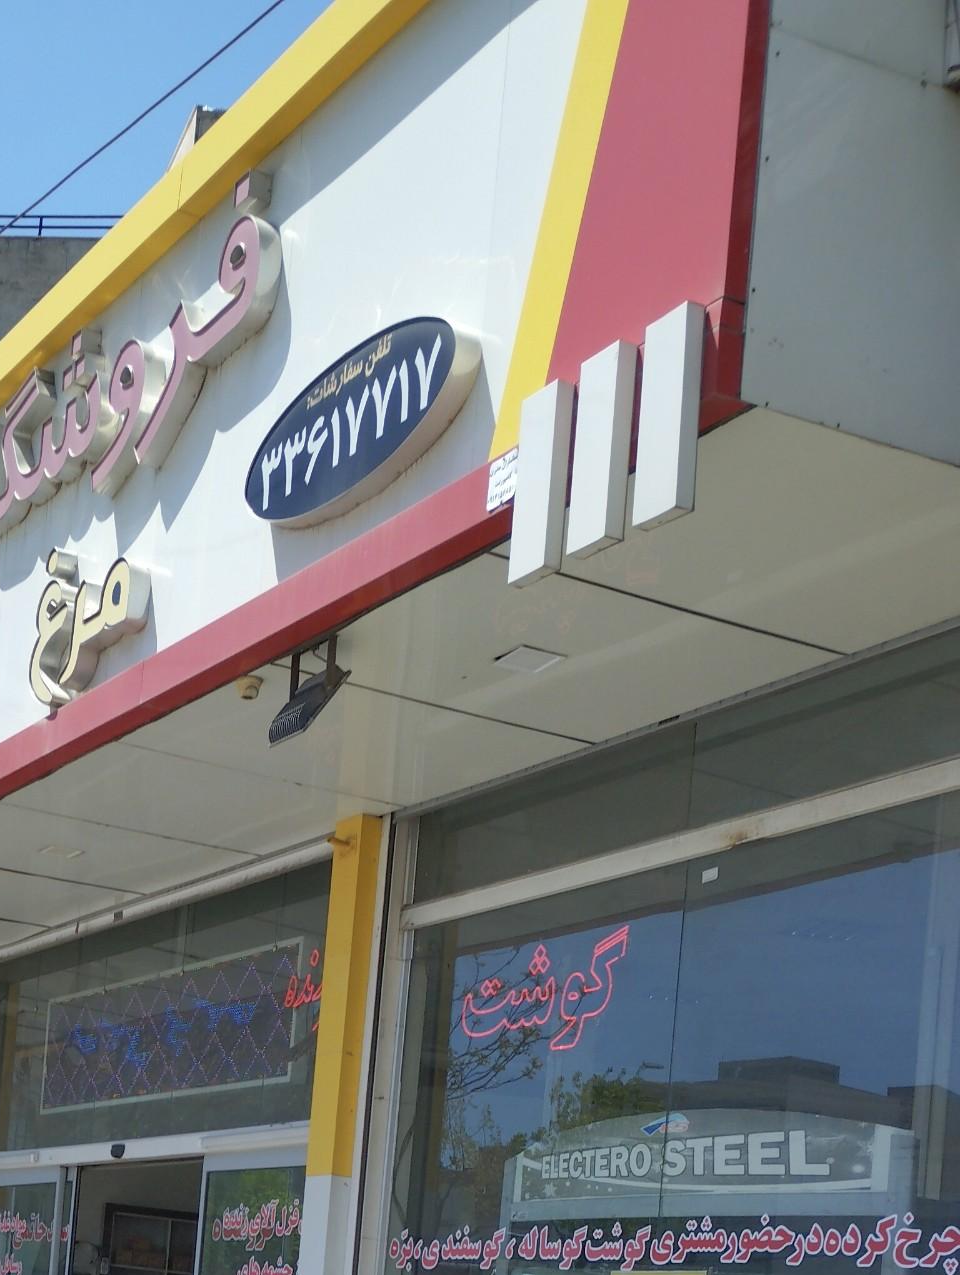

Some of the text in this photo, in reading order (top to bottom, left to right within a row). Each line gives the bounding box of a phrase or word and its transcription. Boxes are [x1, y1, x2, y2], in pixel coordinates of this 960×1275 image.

[365, 334, 393, 378] تلفن
[261, 333, 442, 512] ۳۳۶۱۷۷۱۷
[29, 547, 143, 708] مرغ
[461, 924, 630, 1051] گوشت
[540, 1129, 831, 1180] ELECTERO STEEL
[275, 1199, 300, 1238] قزل
[650, 1216, 728, 1265] مشتری
[721, 1214, 795, 1264] حضور
[823, 1215, 898, 1268] کرده
[585, 1222, 652, 1272] گوشت
[786, 1223, 825, 1266] در
